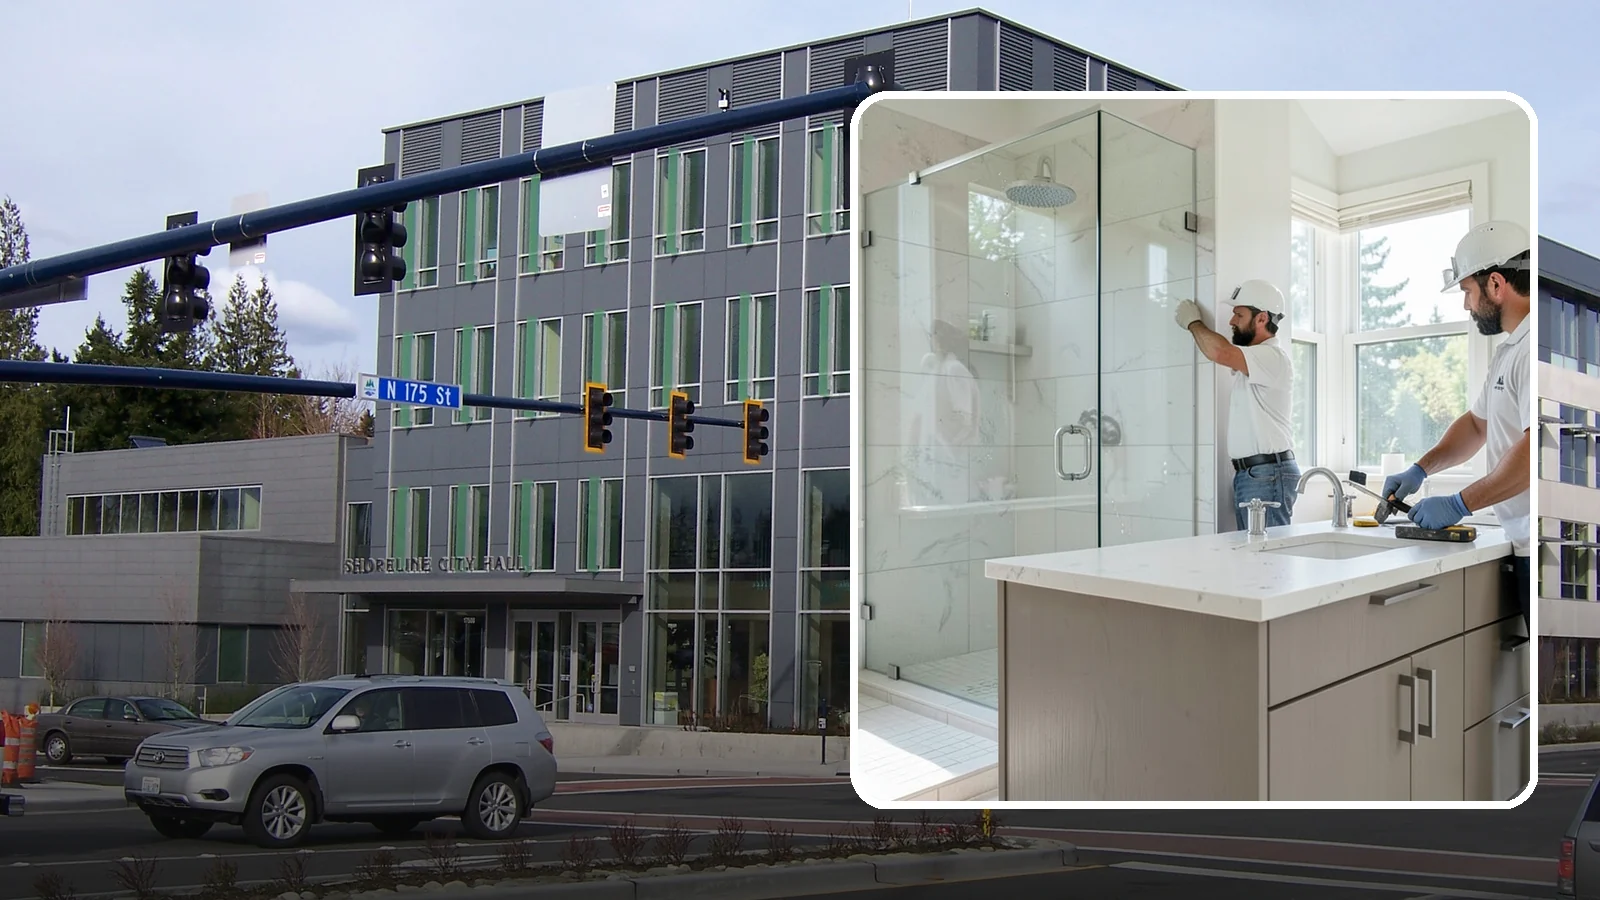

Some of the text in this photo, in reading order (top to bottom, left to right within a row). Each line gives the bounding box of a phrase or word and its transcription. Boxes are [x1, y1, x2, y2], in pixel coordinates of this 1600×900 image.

[387, 380, 451, 406] N 175 St
[343, 555, 525, 574] SHORELINE CITY HALL
